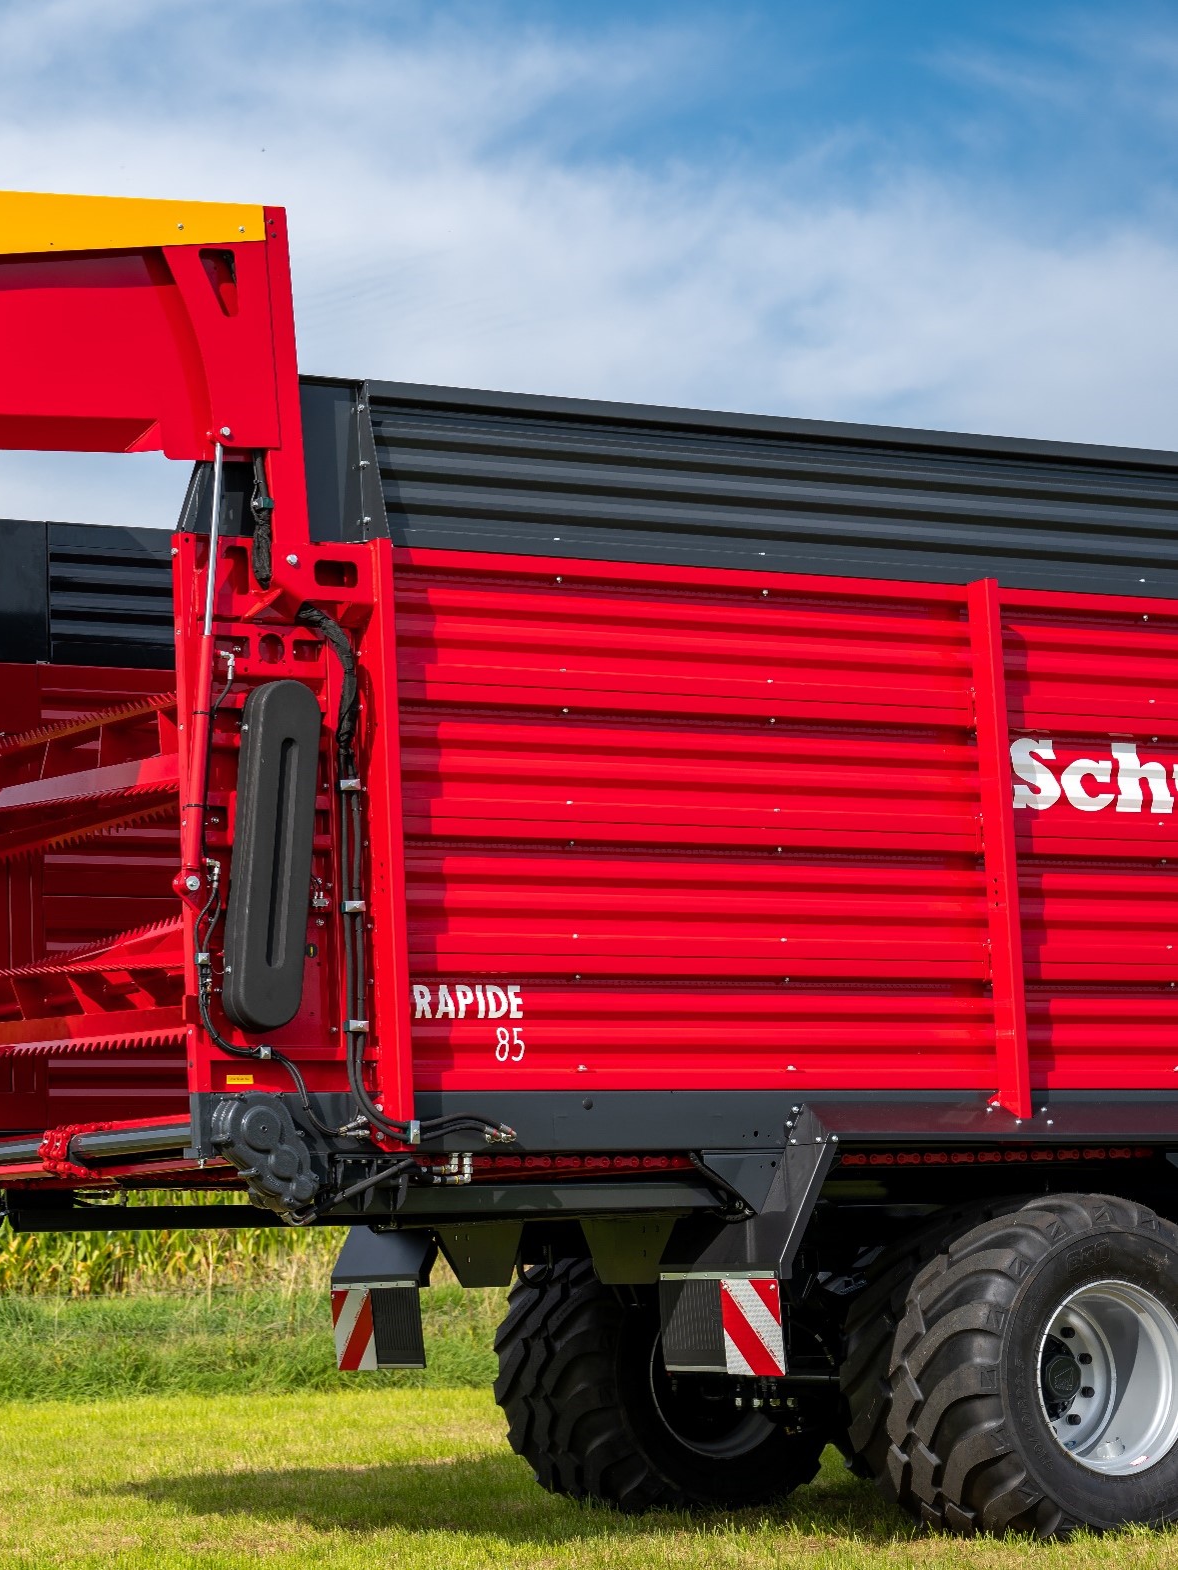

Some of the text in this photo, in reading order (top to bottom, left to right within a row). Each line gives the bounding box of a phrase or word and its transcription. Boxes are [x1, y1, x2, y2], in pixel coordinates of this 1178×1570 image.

[1010, 738, 1178, 814] Sch
[412, 984, 524, 1019] RAPIDE
[495, 1026, 525, 1062] 85
